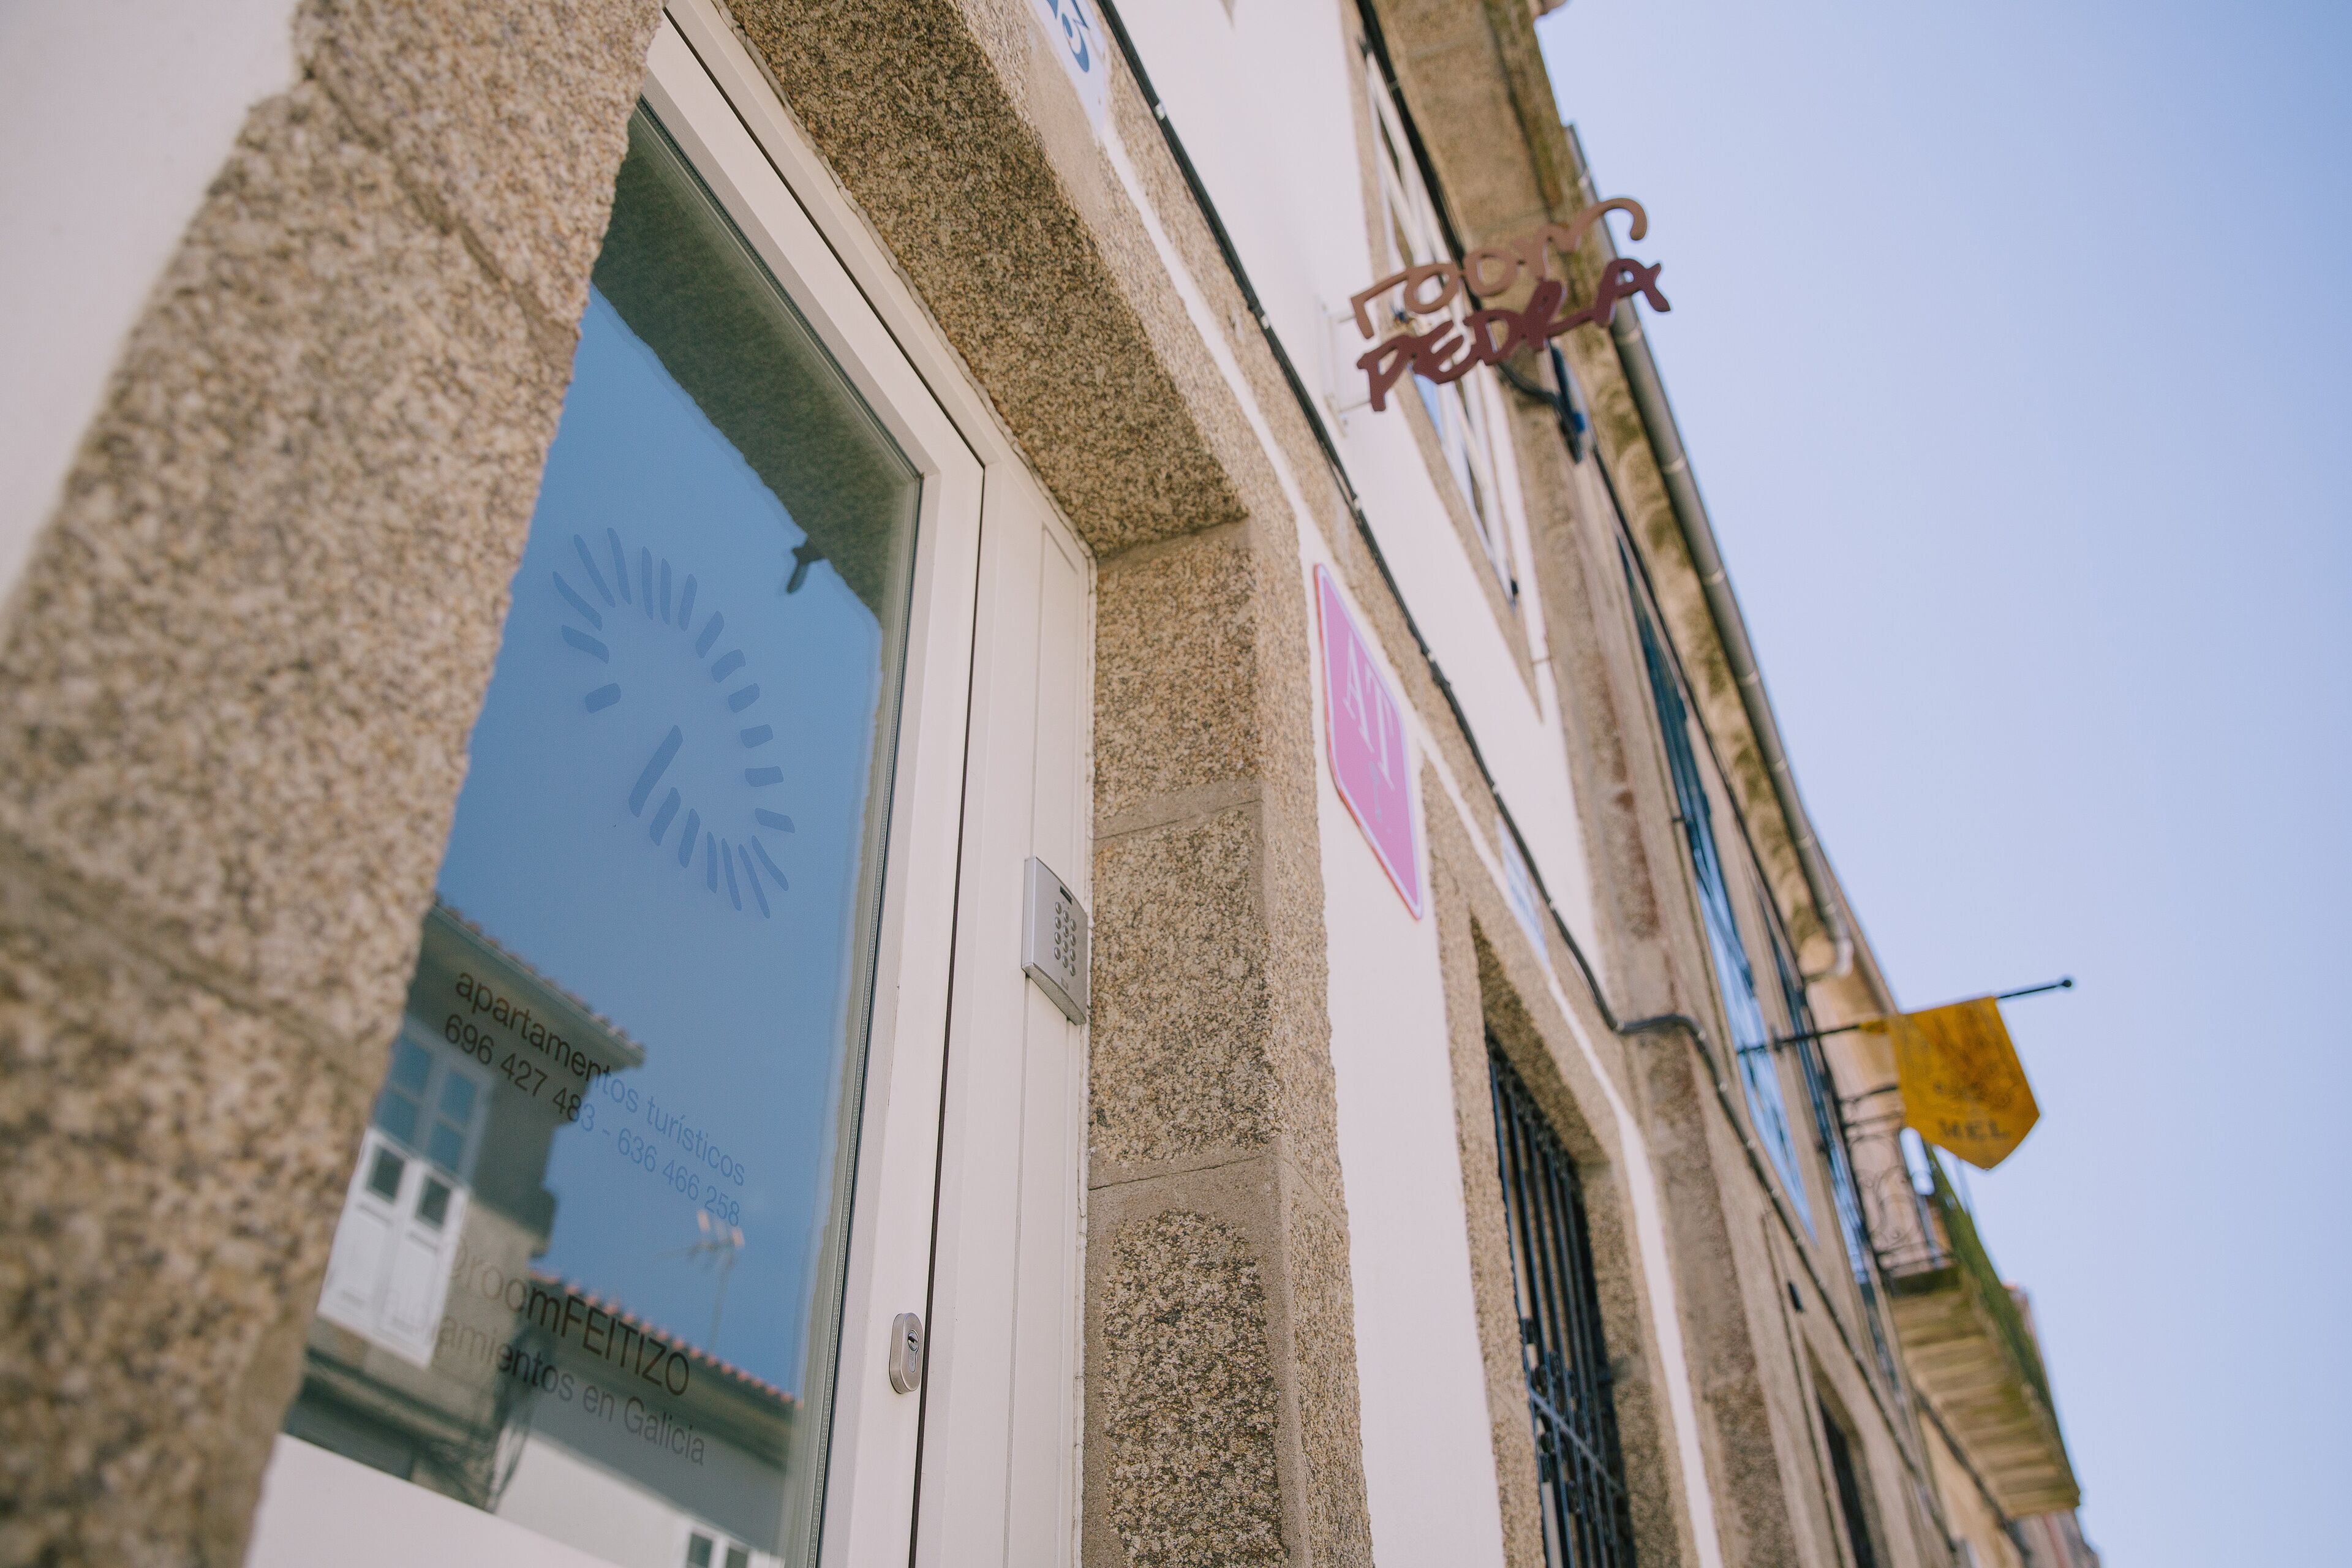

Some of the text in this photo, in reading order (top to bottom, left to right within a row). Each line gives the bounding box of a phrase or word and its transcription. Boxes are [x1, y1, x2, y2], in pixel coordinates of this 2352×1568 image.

[1357, 258, 1671, 412] PEDRA
[1343, 627, 1395, 791] AT
[445, 1014, 494, 1066] 696
[500, 1052, 548, 1097] 427
[552, 1086, 596, 1132] 483
[617, 1127, 657, 1173] 636
[662, 1159, 700, 1201] 466
[704, 1184, 741, 1226] 258
[454, 971, 746, 1187] apartamentos turísticos
[582, 1383, 616, 1423] en
[624, 1395, 706, 1466] Galicia
